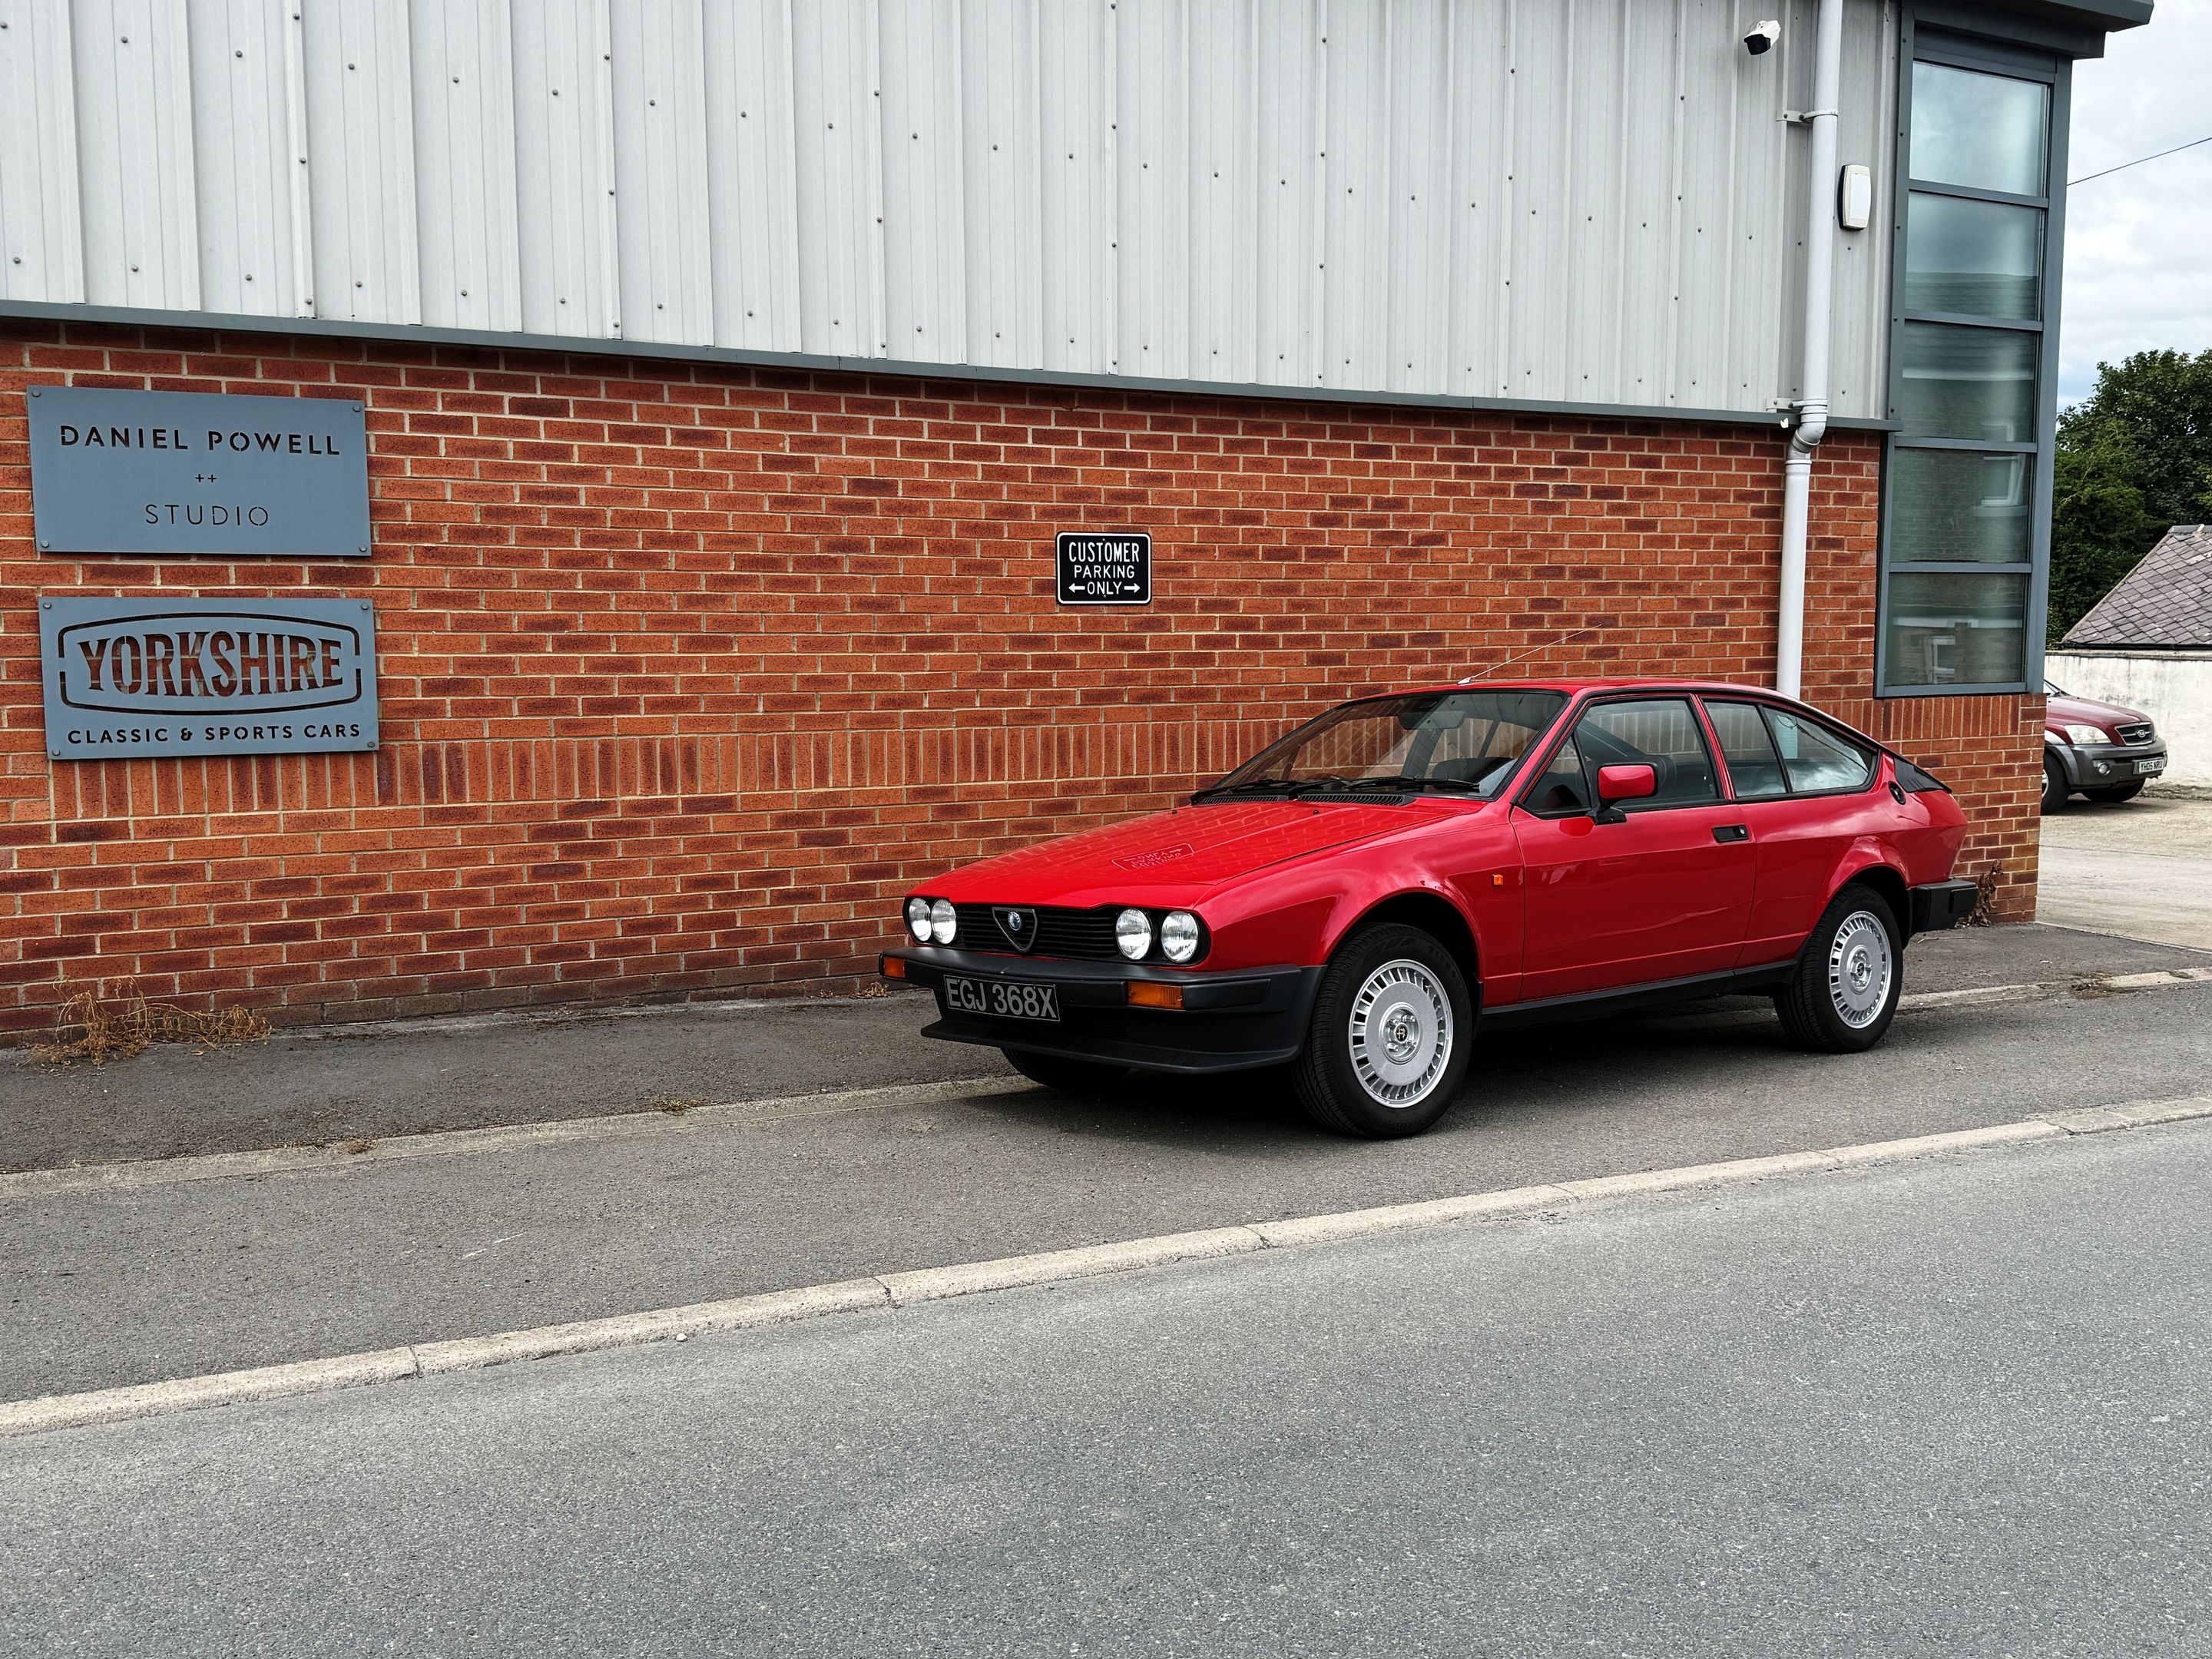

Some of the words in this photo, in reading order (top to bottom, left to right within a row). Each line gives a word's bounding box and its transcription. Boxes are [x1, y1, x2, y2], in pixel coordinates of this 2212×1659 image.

[61, 425, 188, 450] DANIEL
[207, 430, 339, 455] POWELL
[145, 504, 269, 526] STUDIO
[1068, 541, 1140, 562] CUSTOMER
[1074, 565, 1135, 578] PARKING
[1087, 581, 1122, 594] ONLY
[78, 631, 343, 697] YORKSHIRE
[68, 728, 168, 744] CLASSIC
[180, 728, 193, 741] &
[205, 725, 293, 741] SPORTS
[303, 724, 359, 738] CARS
[945, 978, 987, 1012] EGJ
[992, 984, 1057, 1018] 368X
